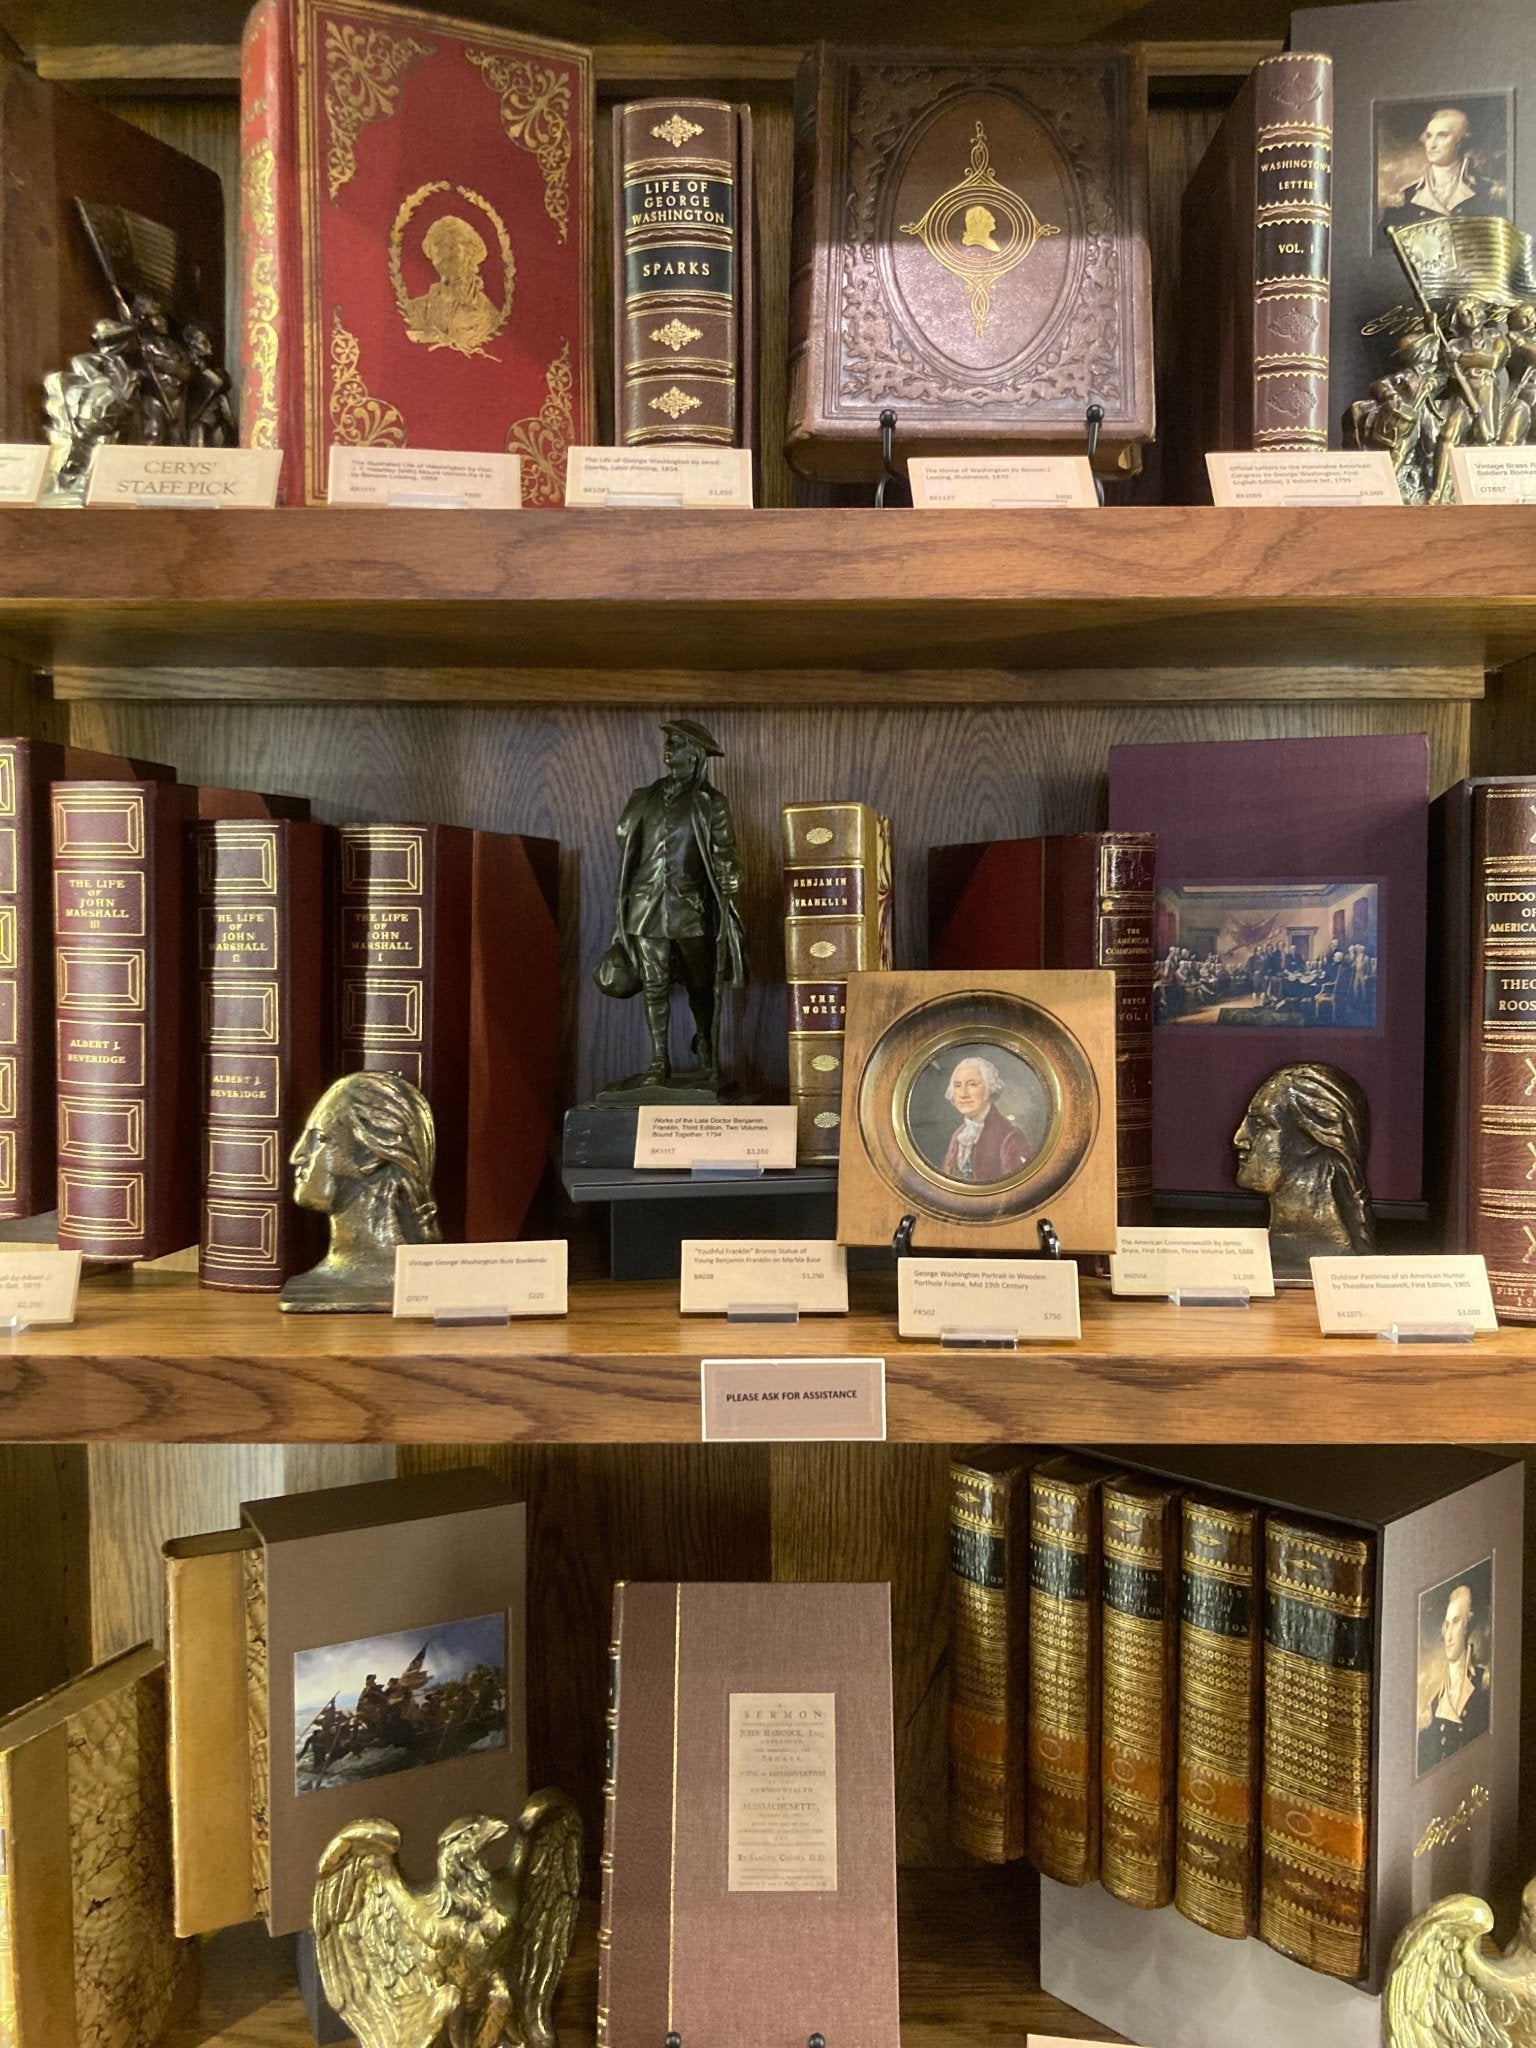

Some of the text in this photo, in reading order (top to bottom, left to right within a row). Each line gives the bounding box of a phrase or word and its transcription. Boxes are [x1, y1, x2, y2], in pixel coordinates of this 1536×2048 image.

[1261, 159, 1331, 174] WASHINGTON'S
[645, 180, 708, 194] LIFE OF
[1278, 180, 1318, 190] LETTERS
[644, 195, 710, 208] GEORGE
[631, 209, 725, 225] WASHINGTON
[1278, 243, 1304, 254] VOL.
[642, 261, 710, 277] SPARKS
[116, 479, 238, 495] STAFF PICK
[69, 879, 125, 889] THE LIFE
[793, 877, 847, 887] BENJAMIN
[88, 889, 103, 898] OF
[80, 898, 115, 908] JOHN
[794, 898, 848, 907] FRANKLIN
[65, 908, 130, 918] MARSHALL
[237, 913, 264, 923] LIFE
[381, 913, 409, 922] LIFE
[229, 923, 242, 931] OF
[373, 922, 387, 930] OF
[222, 932, 255, 942] JOHN
[810, 994, 835, 1003] THE
[802, 1005, 846, 1014] WORKS
[70, 1039, 110, 1049] ALBERT
[67, 1053, 127, 1064] BEVERIDGE
[212, 1074, 250, 1084] ALBERT
[210, 1088, 267, 1100] BEVERIDGE
[733, 1117, 763, 1126] Benjamin
[434, 1259, 459, 1267] George
[460, 1258, 498, 1266] Washington
[914, 1270, 938, 1278] George
[939, 1271, 980, 1280] Washington
[981, 1272, 1007, 1280] Portrait
[914, 1279, 942, 1287] Porthole
[944, 1280, 968, 1288] Frame,
[1001, 1282, 1029, 1290] Century
[1375, 1282, 1410, 1290] Roosevelt,
[1427, 1281, 1453, 1289] Edition,
[1496, 1286, 1526, 1297] FIRST
[726, 1389, 858, 1402] PLEASE ASK FOR ASSISTANCE
